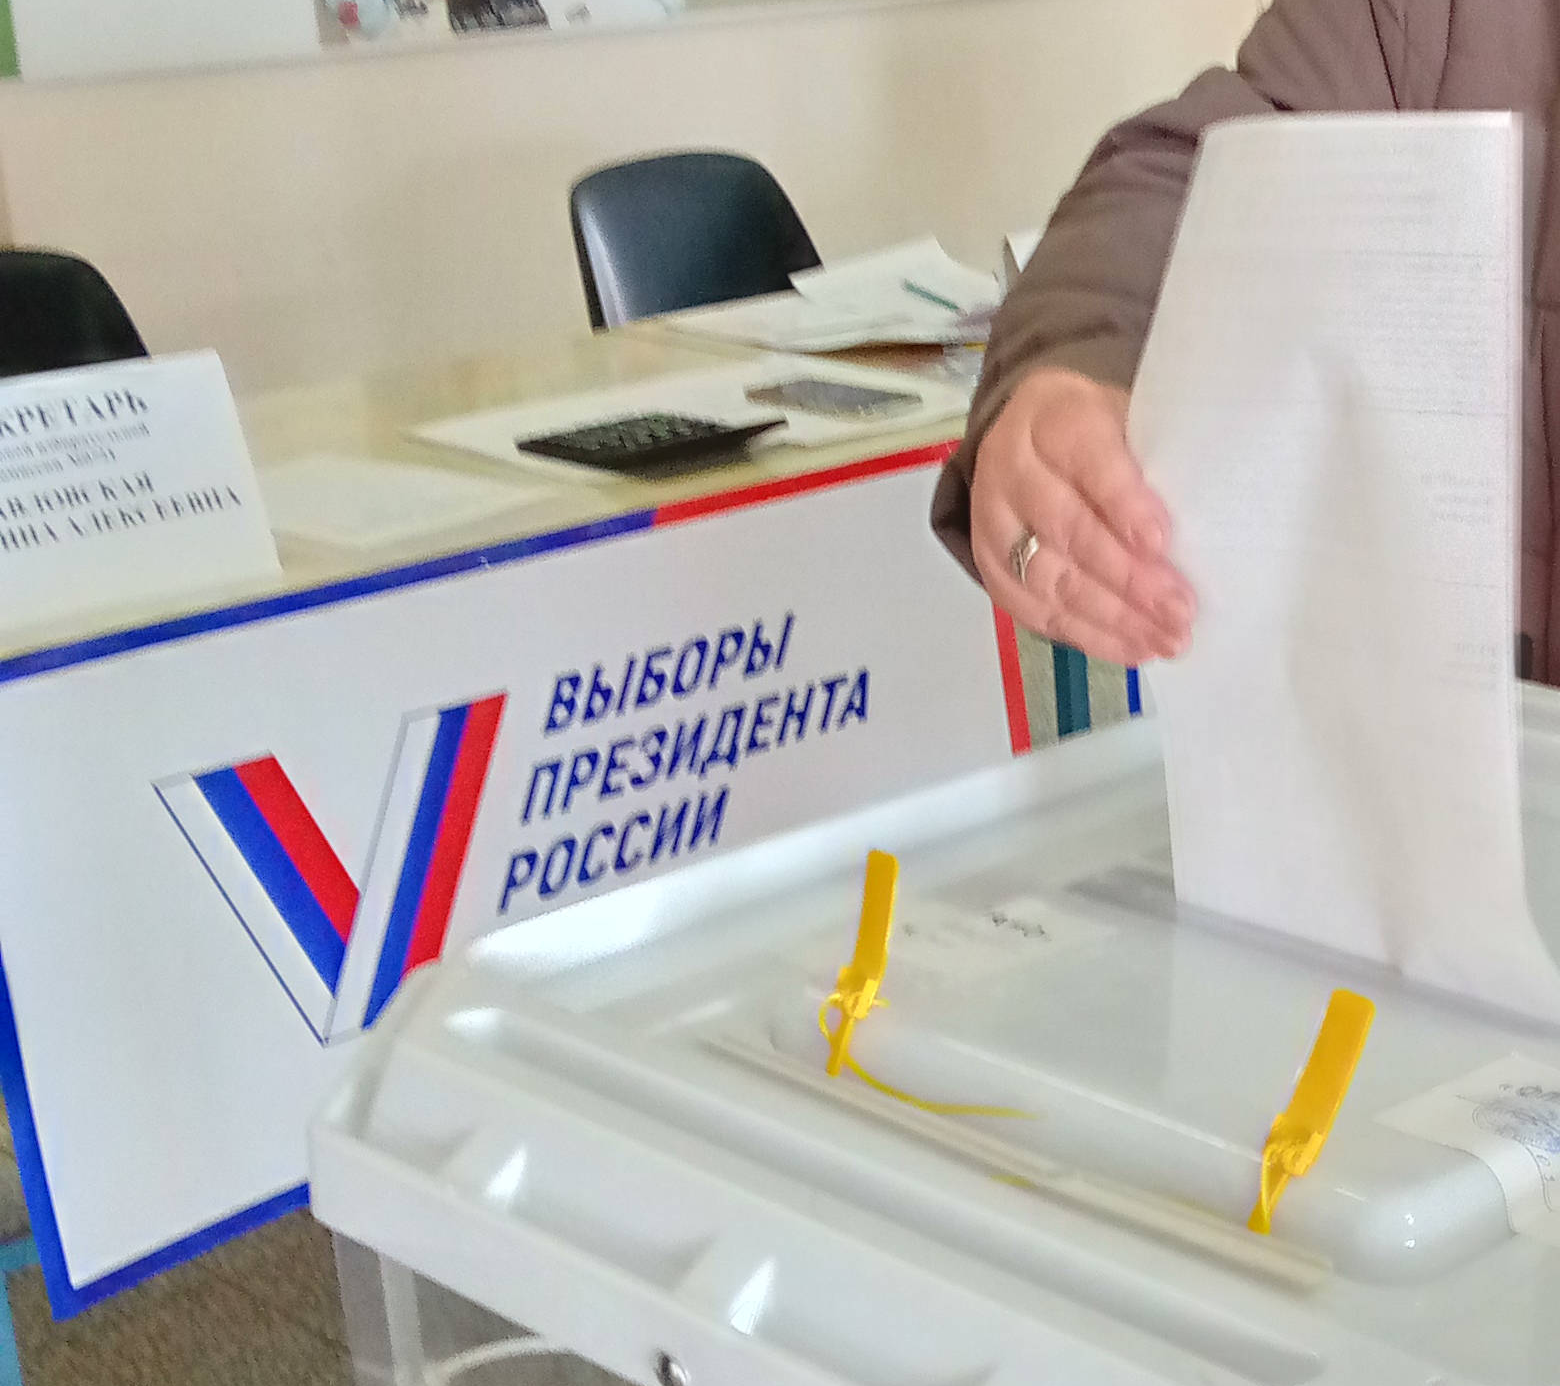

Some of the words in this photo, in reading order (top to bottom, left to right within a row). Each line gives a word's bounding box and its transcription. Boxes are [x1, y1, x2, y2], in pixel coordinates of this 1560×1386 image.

[543, 614, 794, 735] ВЫБОРЫ
[520, 669, 870, 824] ПРЕЗИДЕНТА
[499, 787, 730, 914] РОССИИ
